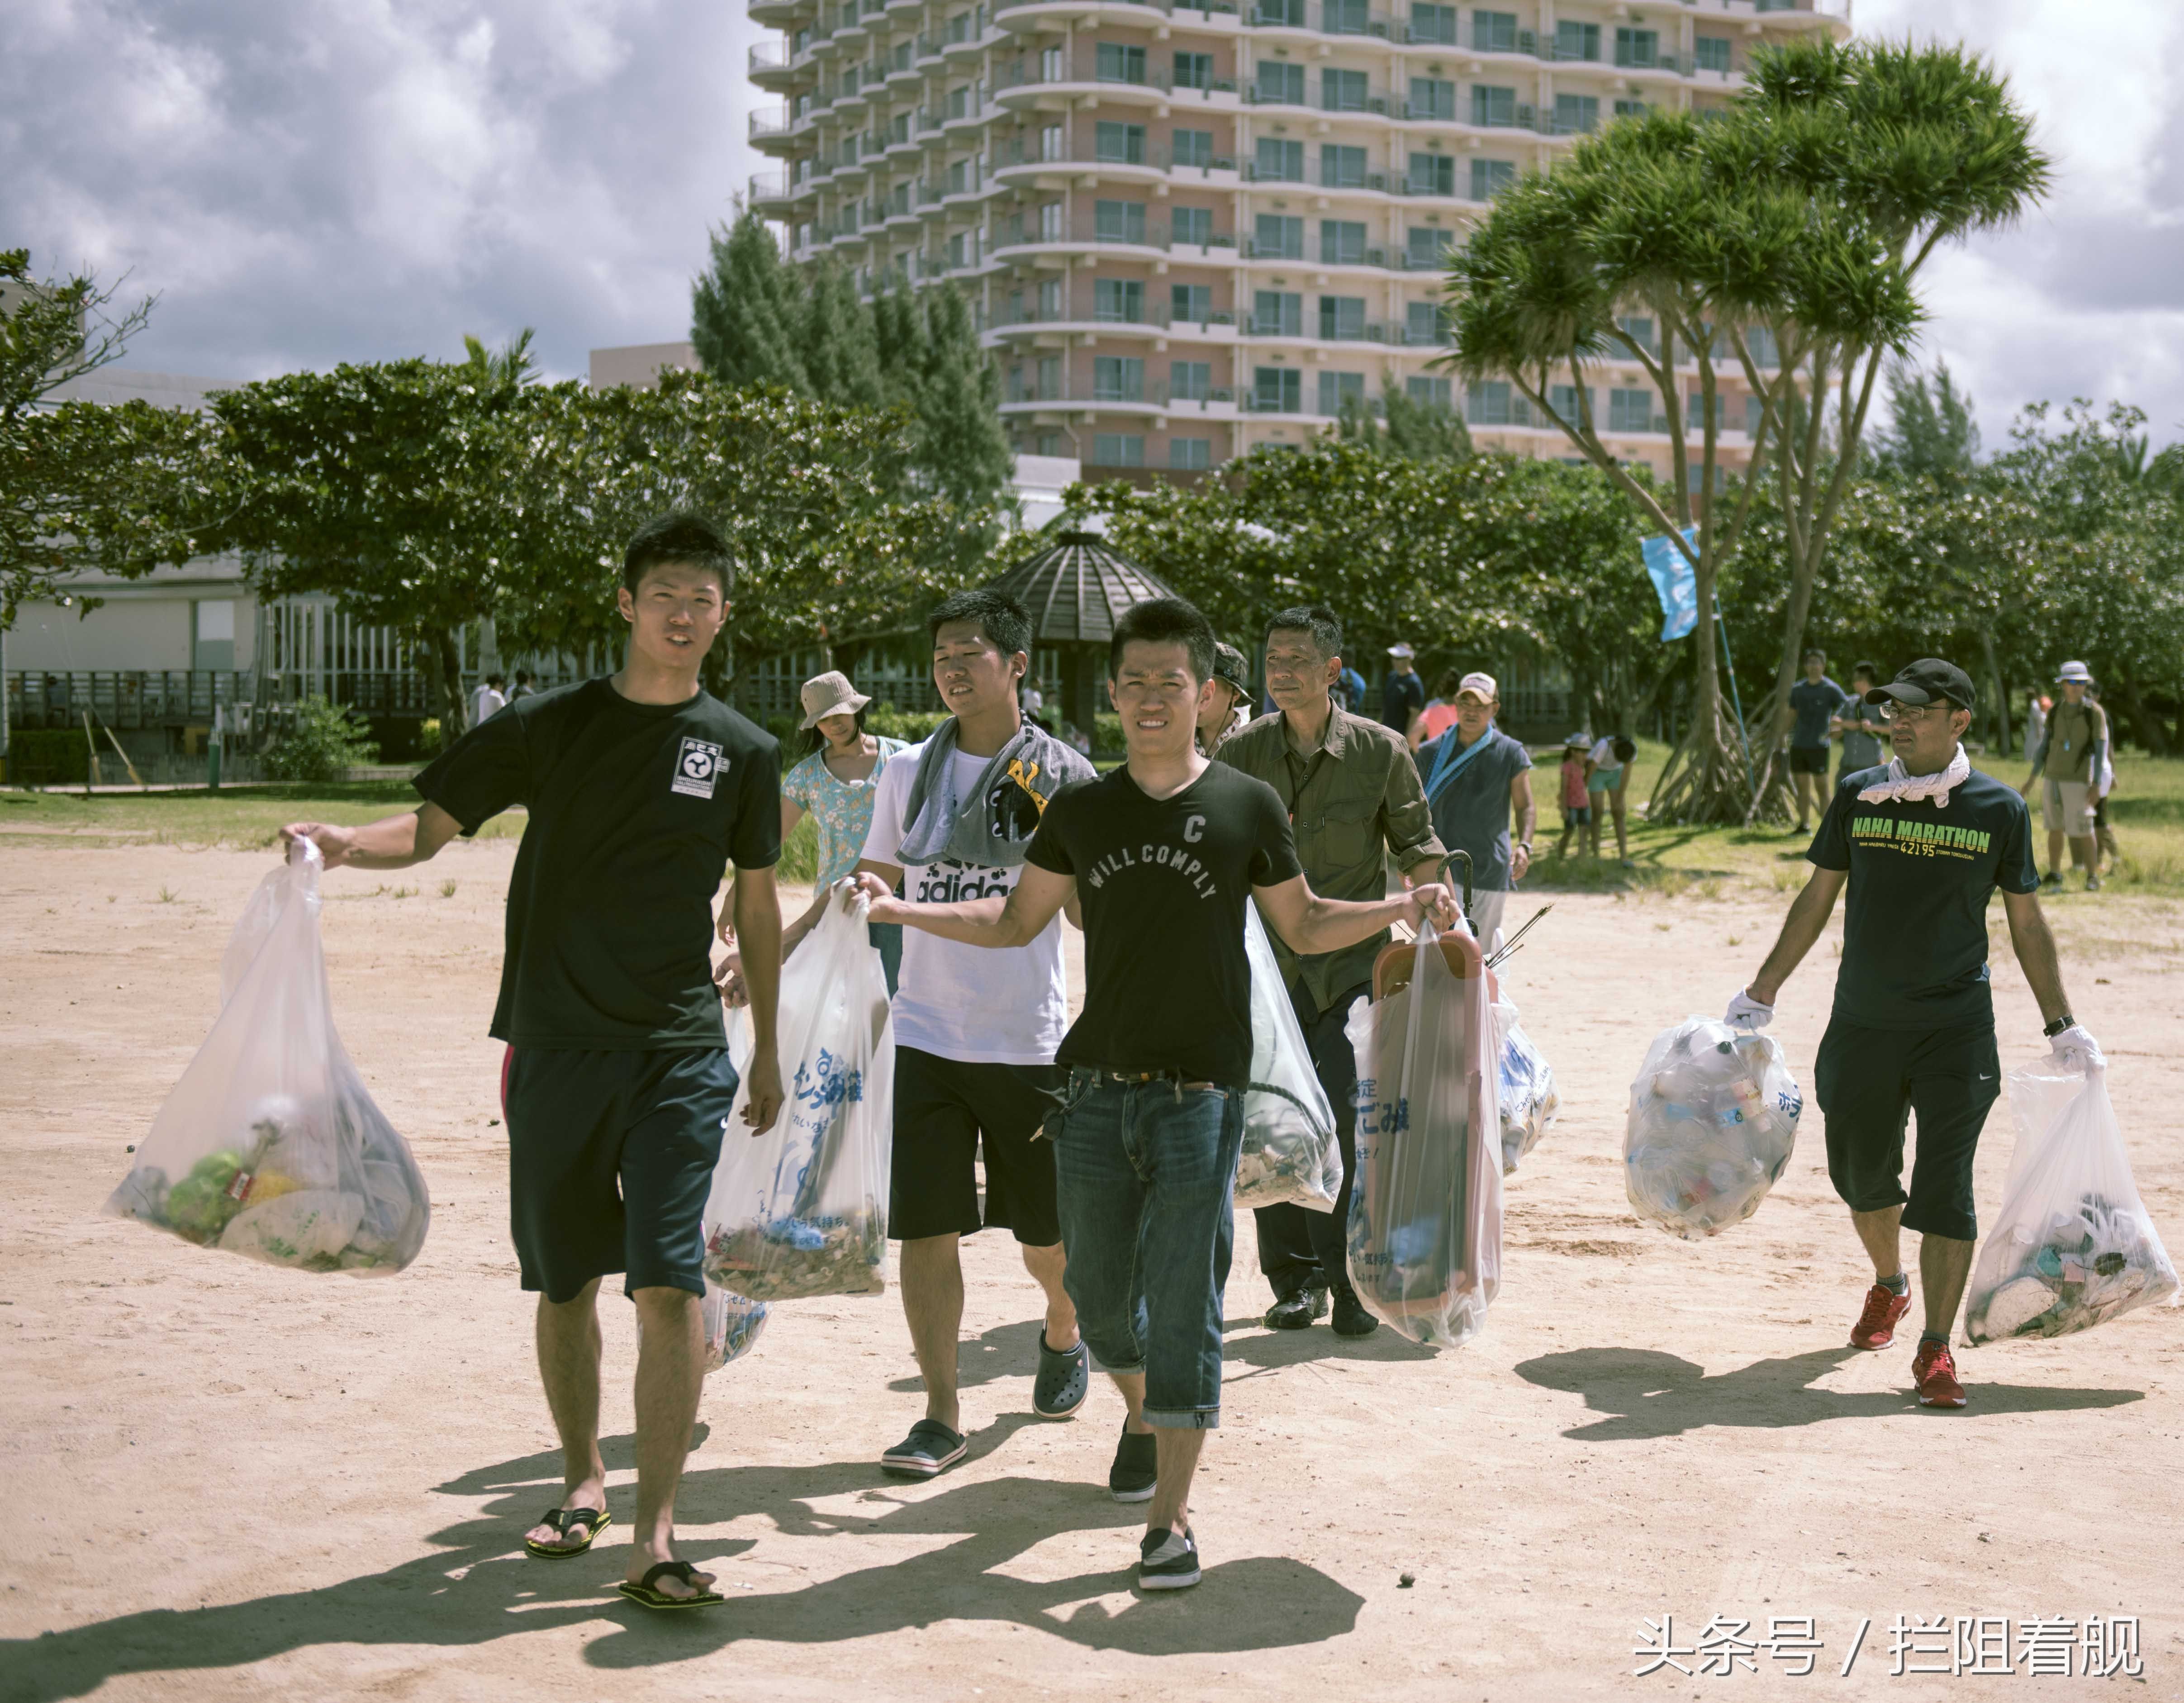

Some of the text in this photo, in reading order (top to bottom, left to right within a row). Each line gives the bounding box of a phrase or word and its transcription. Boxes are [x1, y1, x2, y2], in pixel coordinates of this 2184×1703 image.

[1183, 815, 1206, 843] C
[1852, 818, 1990, 854] NAHA MARATHON
[1089, 844, 1216, 899] WILL COMPLY
[916, 874, 1017, 903] adida
